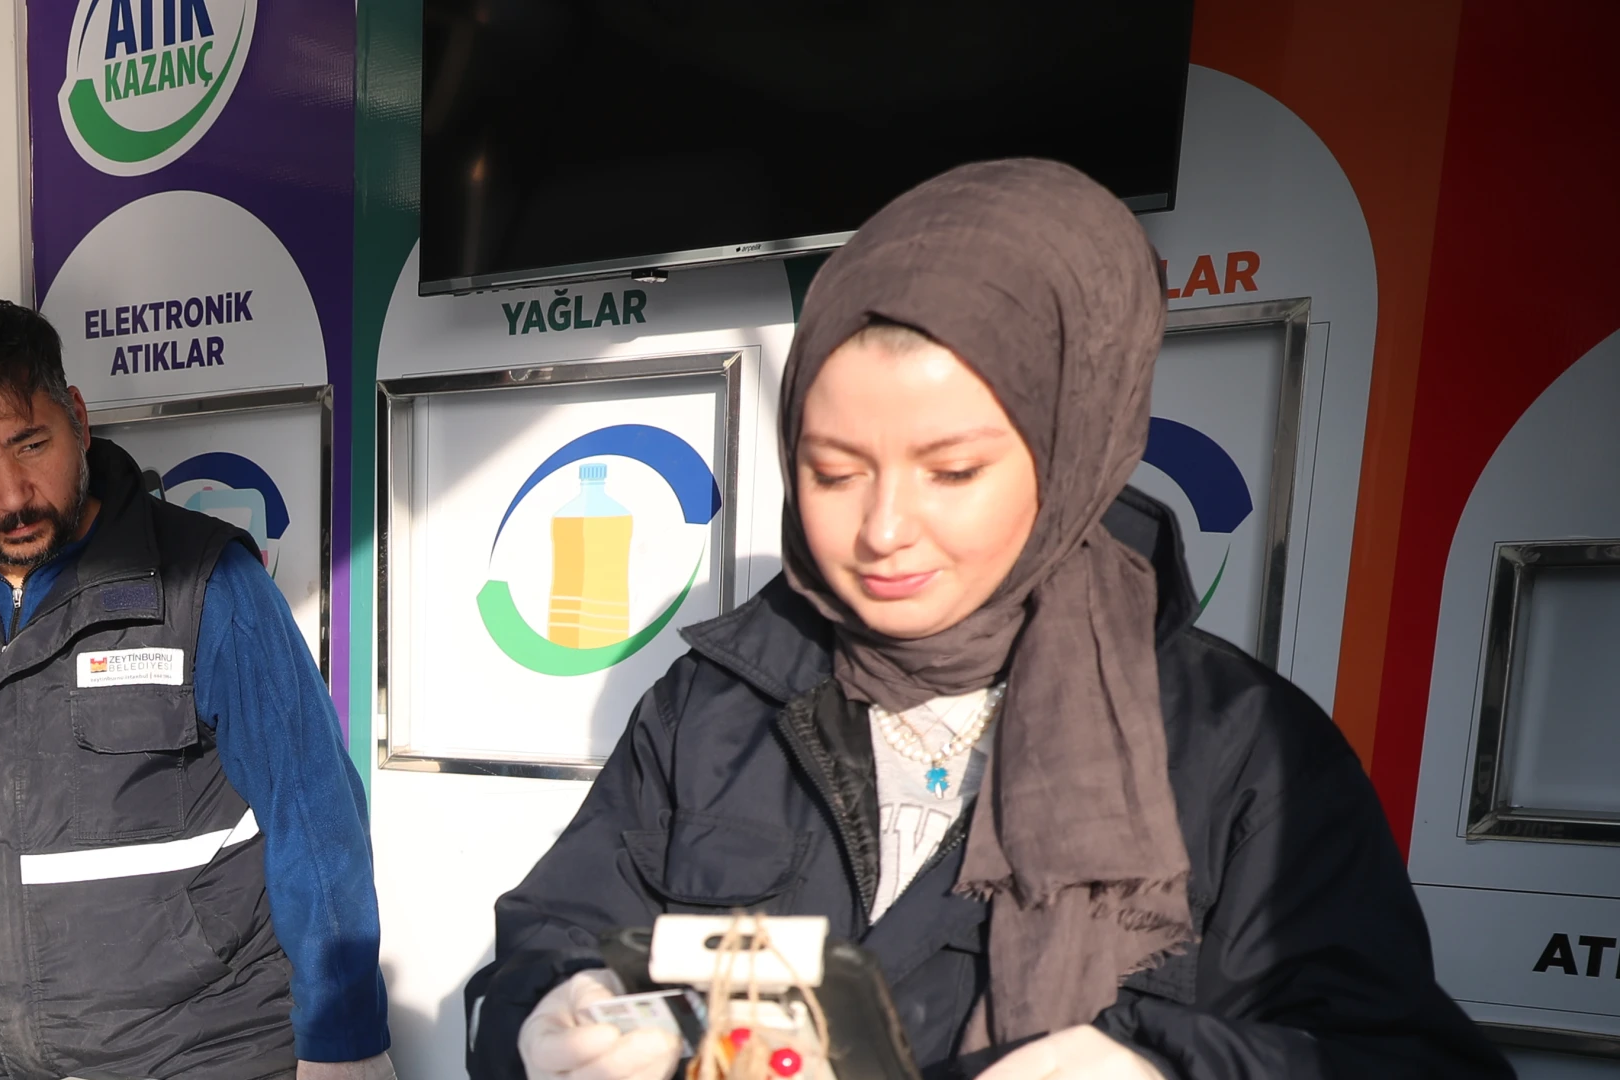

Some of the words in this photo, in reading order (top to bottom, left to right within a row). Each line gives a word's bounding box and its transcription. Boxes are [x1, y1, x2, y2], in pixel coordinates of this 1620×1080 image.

[105, 40, 214, 103] KAZANÇ
[501, 288, 647, 336] YAĞLAR
[110, 336, 225, 376] ATIKLAR
[109, 653, 173, 664] ZEYTİNBURNU
[1532, 933, 1620, 979] AT
